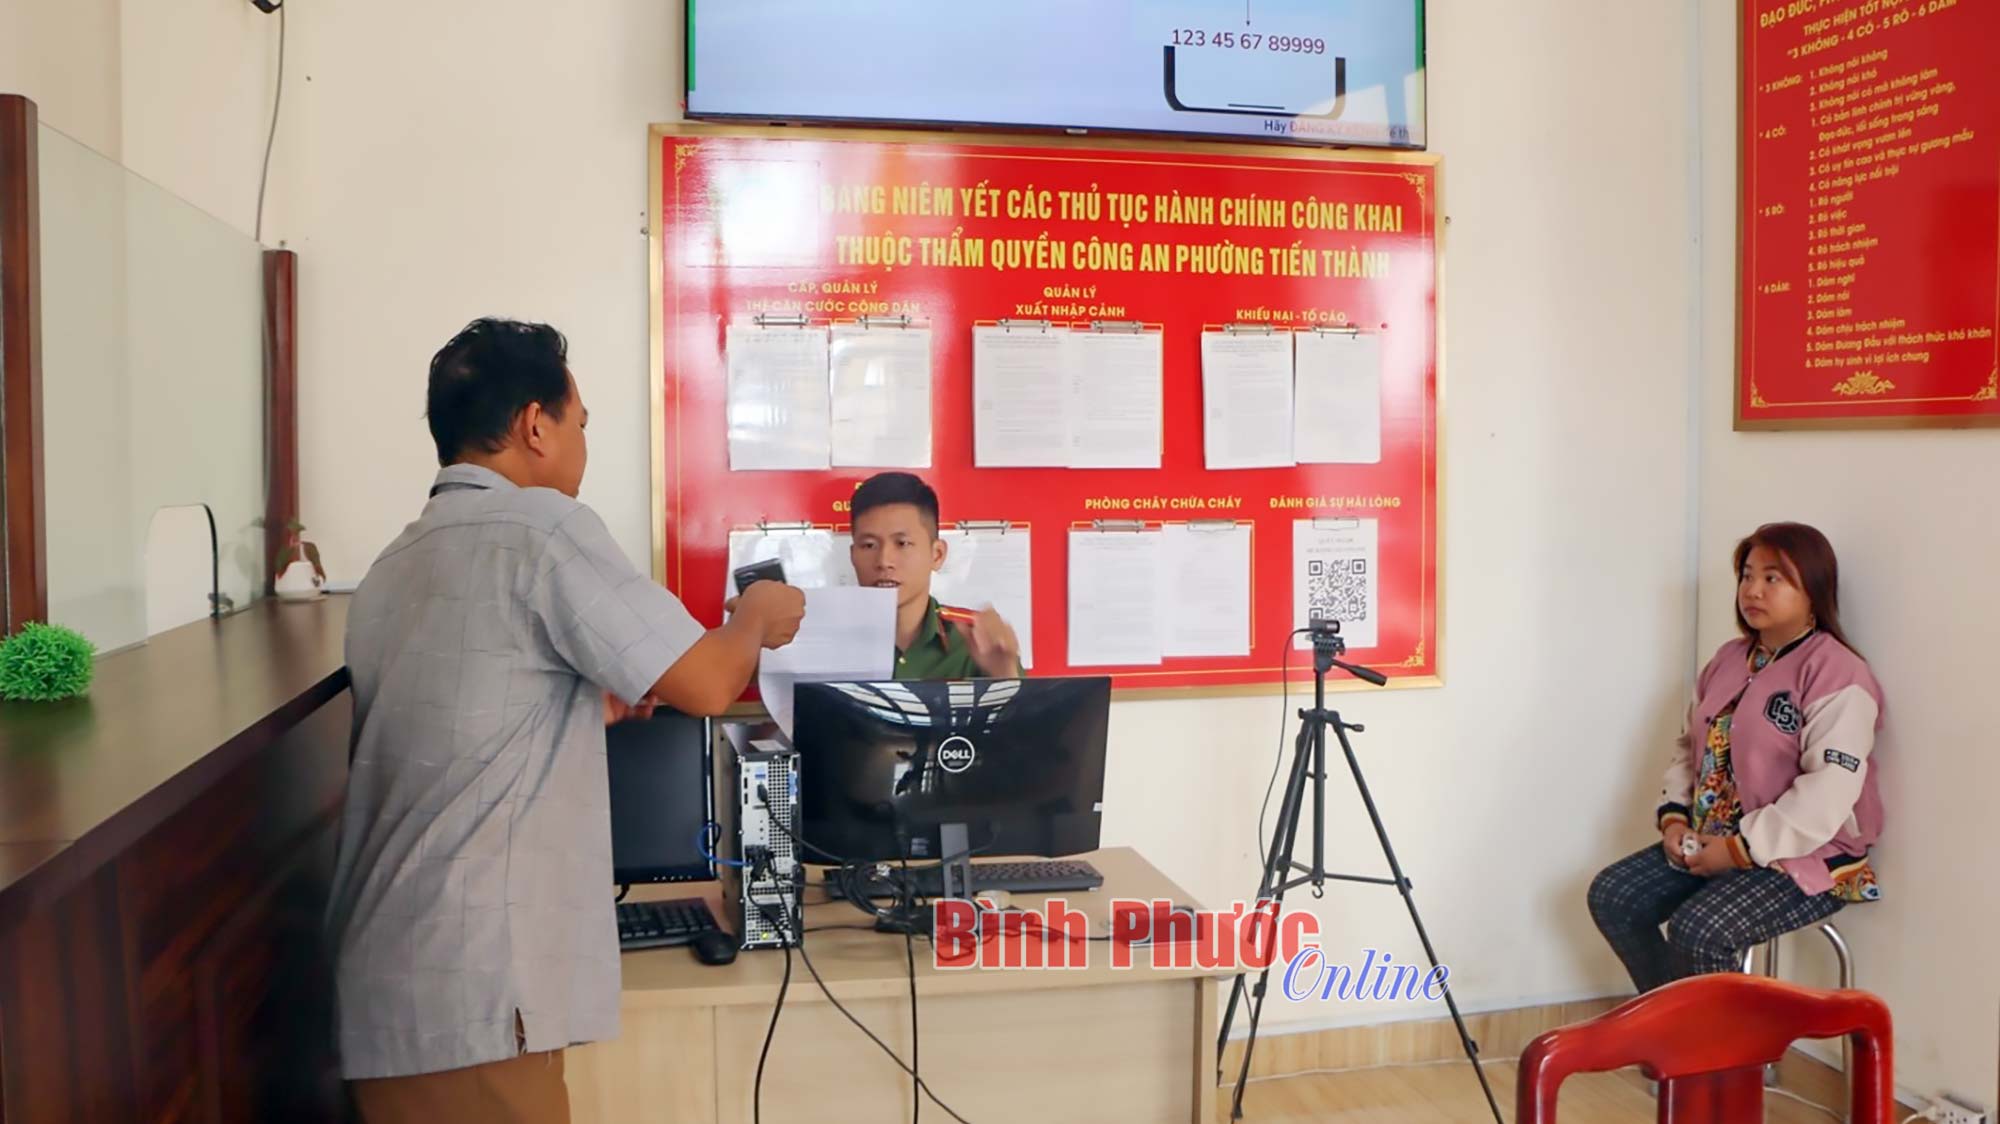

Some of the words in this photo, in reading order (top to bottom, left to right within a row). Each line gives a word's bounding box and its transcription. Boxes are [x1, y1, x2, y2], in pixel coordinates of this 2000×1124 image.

[1760, 7, 1786, 28] ĐẠO
[1804, 18, 1830, 35] THỰC
[1172, 29, 1205, 46] 123
[1212, 32, 1234, 48] 45
[1240, 33, 1262, 50] 67
[1268, 35, 1325, 55] 89999
[1801, 35, 1839, 56] KHÔNG
[1856, 21, 1874, 37] CÓ
[1264, 119, 1287, 134] Hãy
[893, 181, 953, 216] NIÊM
[960, 179, 1001, 217] YẾT
[1007, 184, 1052, 219] CÁC
[1058, 183, 1101, 221] THỦ
[1107, 193, 1148, 228] TỤC
[1154, 189, 1214, 225] HÀNH
[1220, 194, 1286, 228] CHÍNH
[1292, 196, 1348, 231] CÔNG
[1354, 204, 1402, 233] KHAI
[835, 230, 912, 272] THUỘC
[919, 226, 984, 268] THẨM
[991, 231, 1066, 271] QUYỀN
[1072, 236, 1133, 271] CÔNG
[1139, 243, 1170, 272] AN
[1175, 239, 1263, 276] PHƯỜNG
[1269, 240, 1317, 277] TIẾN
[1322, 246, 1390, 278] THÀNH
[822, 280, 860, 294] QUẢN
[863, 281, 879, 294] LÝ
[1043, 283, 1080, 298] QUẢN
[1083, 285, 1097, 298] LÝ
[848, 299, 889, 313] CÔNG
[1016, 301, 1048, 316] XUẤT
[1051, 303, 1086, 319] NHẬP
[1089, 302, 1125, 317] CẢNH
[1236, 306, 1270, 321] KHIẾU
[1273, 309, 1293, 324] NẠI
[1302, 306, 1317, 322] TỐ
[1319, 307, 1347, 322] CÁO
[832, 500, 851, 512] QU
[1085, 496, 1130, 509] PHÒNG
[1133, 495, 1168, 509] CHÁY
[1170, 495, 1206, 509] CHỮA
[1208, 495, 1242, 509] CHÁY
[1269, 495, 1303, 508] ĐÁNH
[1305, 495, 1327, 508] GIÁ
[1329, 497, 1344, 510] SỰ
[1346, 495, 1366, 508] HÀI
[1369, 495, 1401, 508] LÒNG
[942, 749, 971, 760] DELL
